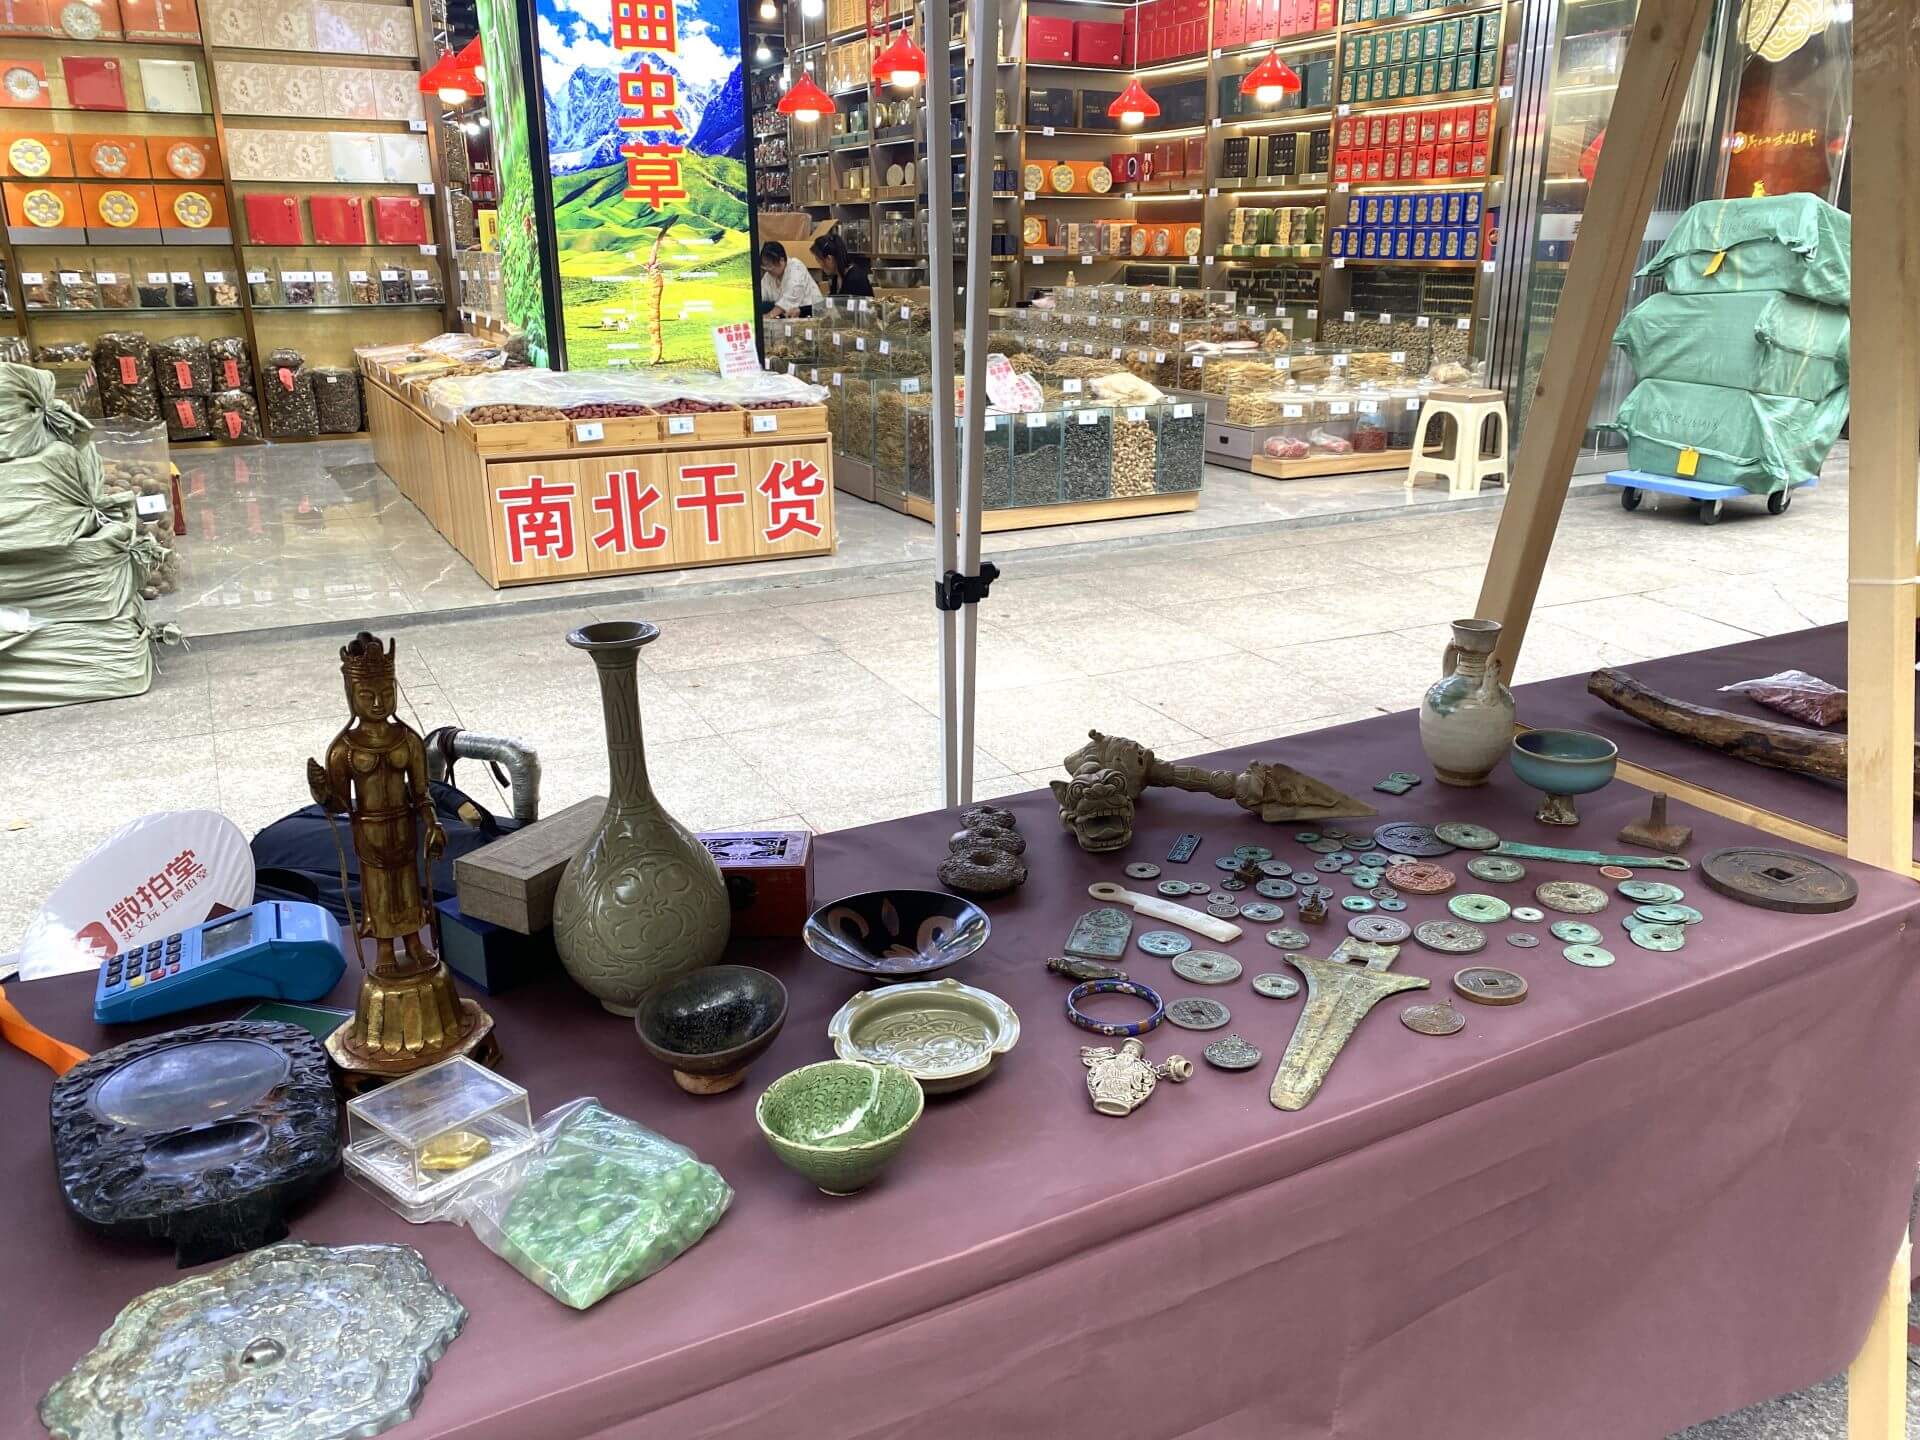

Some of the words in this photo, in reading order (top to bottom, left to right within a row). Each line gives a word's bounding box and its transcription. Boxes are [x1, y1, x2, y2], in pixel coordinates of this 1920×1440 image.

[497, 459, 825, 564] 南北干货
[105, 848, 203, 933] 微拍堂
[121, 868, 209, 942] 买文玩上微拍堂
